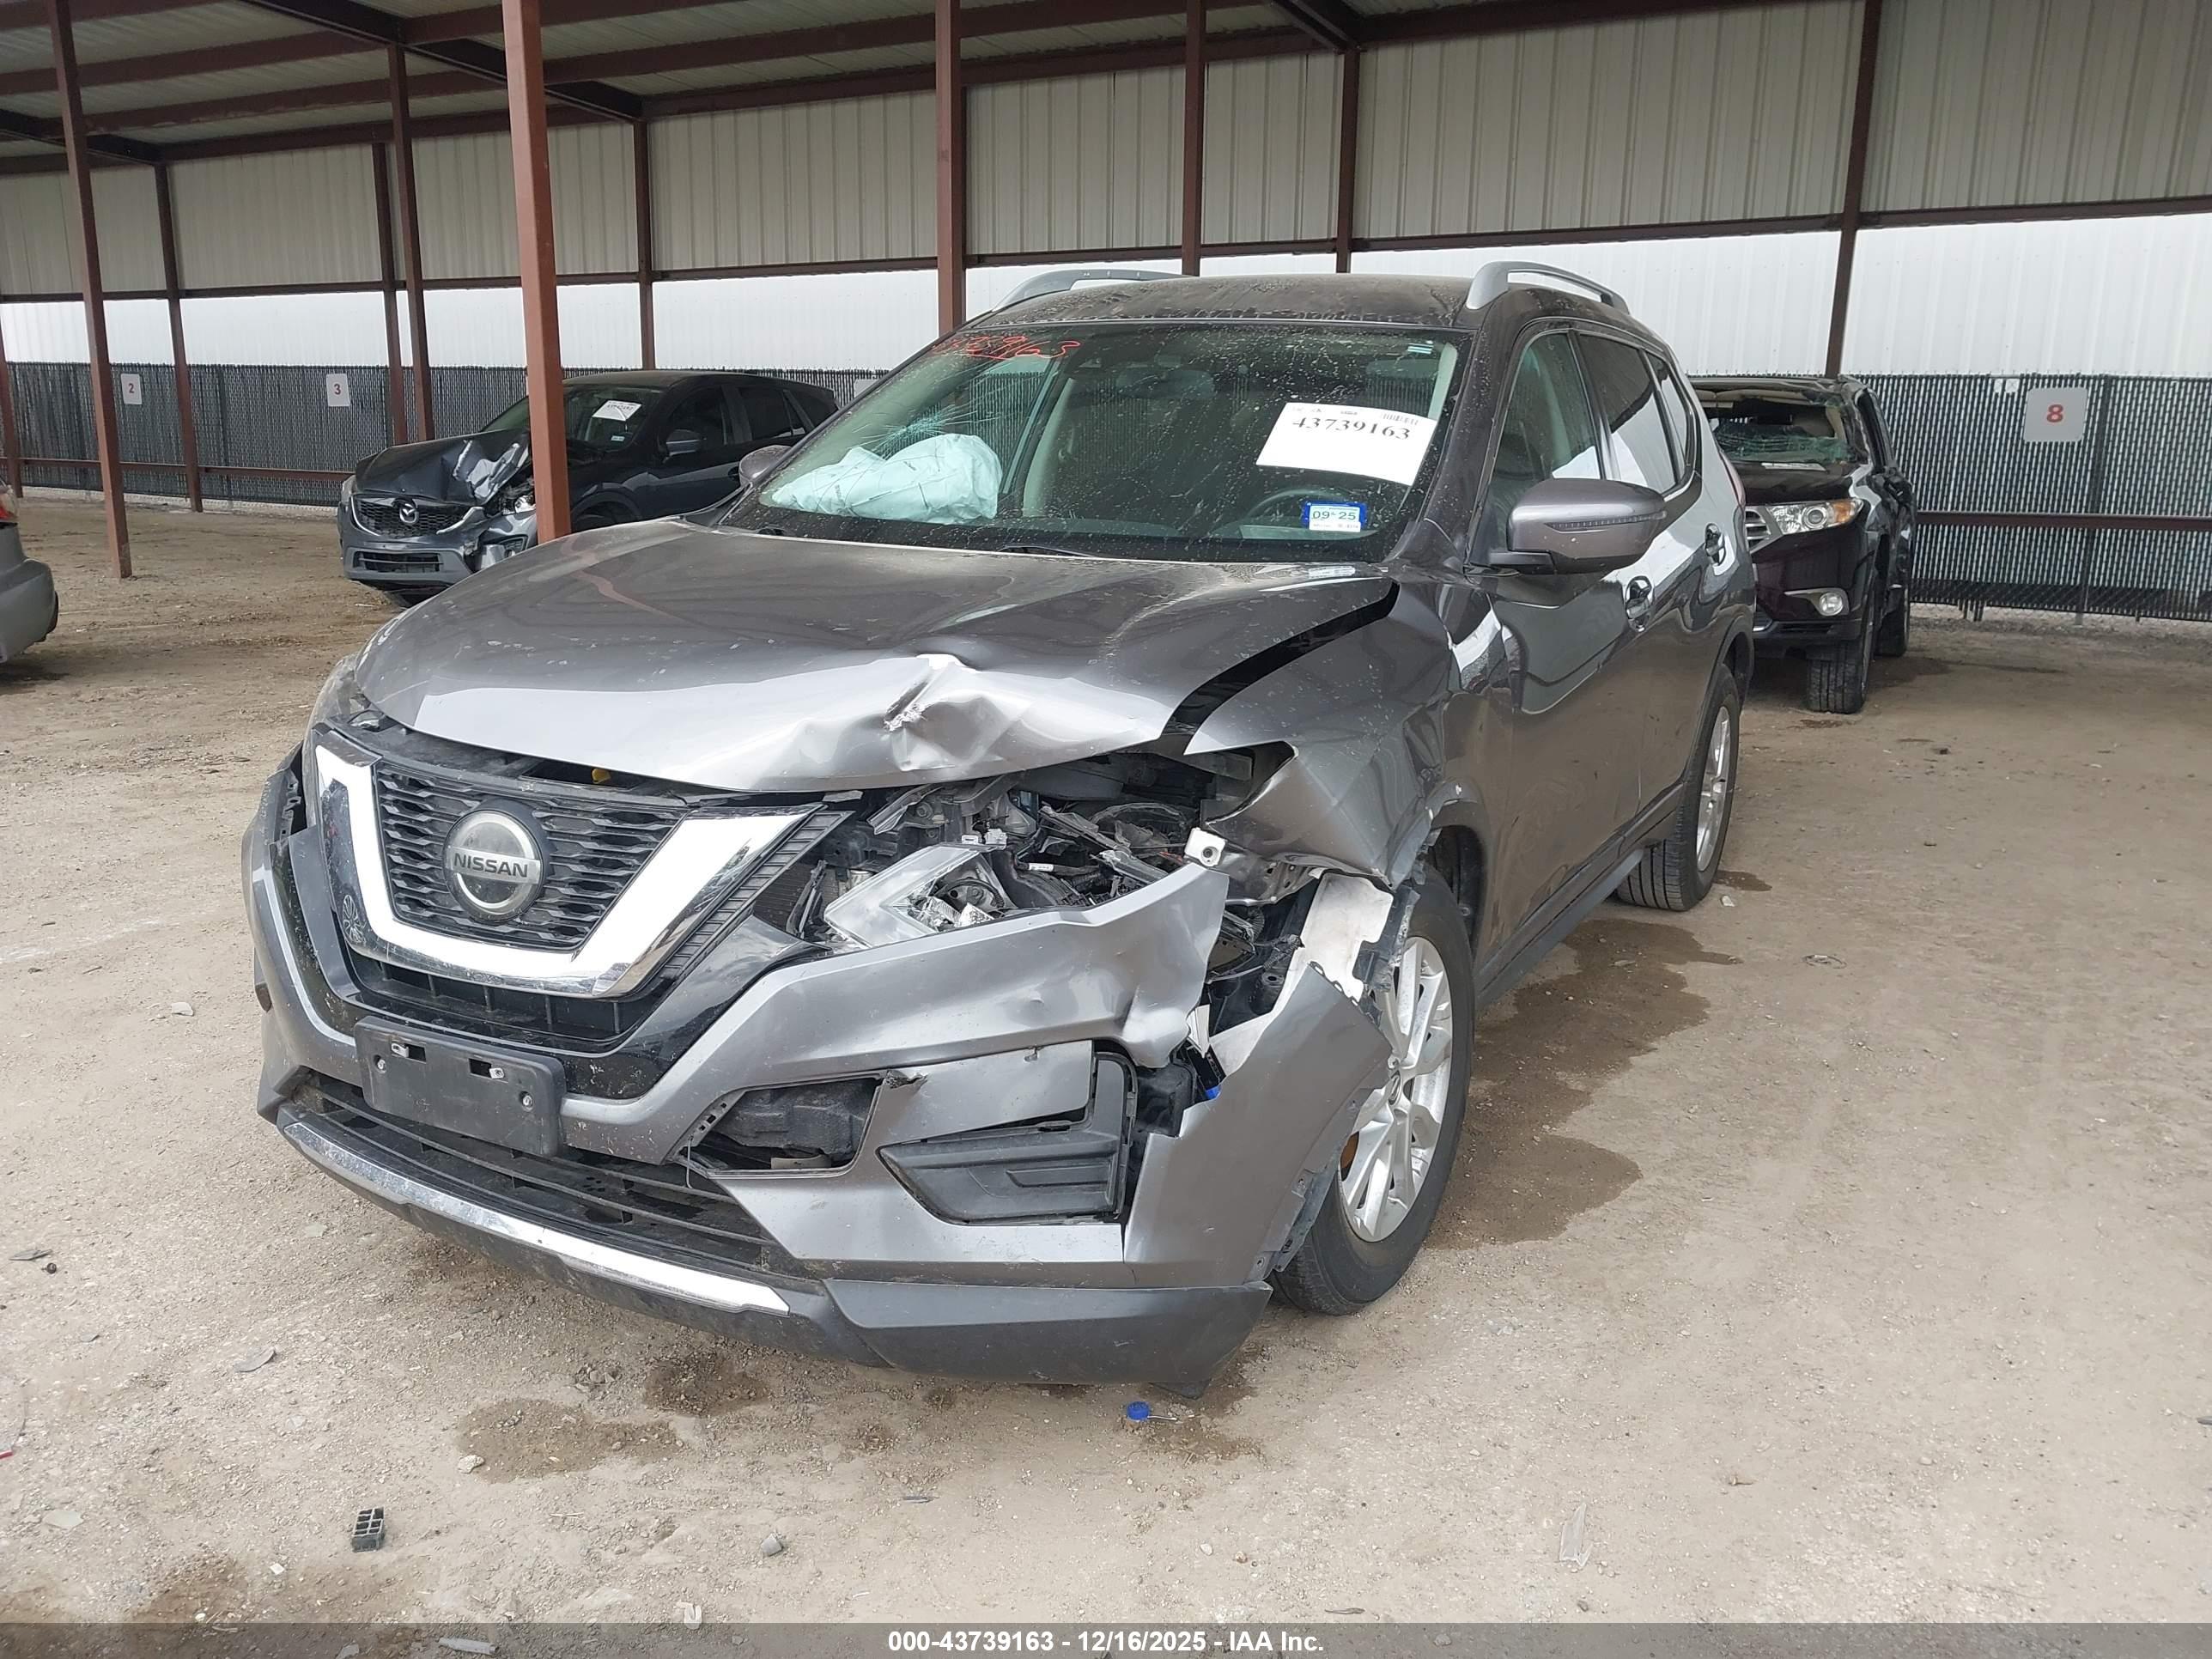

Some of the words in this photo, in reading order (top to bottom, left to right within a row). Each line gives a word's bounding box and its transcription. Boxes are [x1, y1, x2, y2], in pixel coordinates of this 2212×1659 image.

[128, 383, 135, 394] 2
[333, 383, 342, 395] 3
[2046, 404, 2063, 422] 8
[1291, 416, 1411, 441] 43739163
[1312, 510, 1330, 520] 09
[1339, 511, 1357, 520] 25
[453, 852, 528, 878] NISSAN
